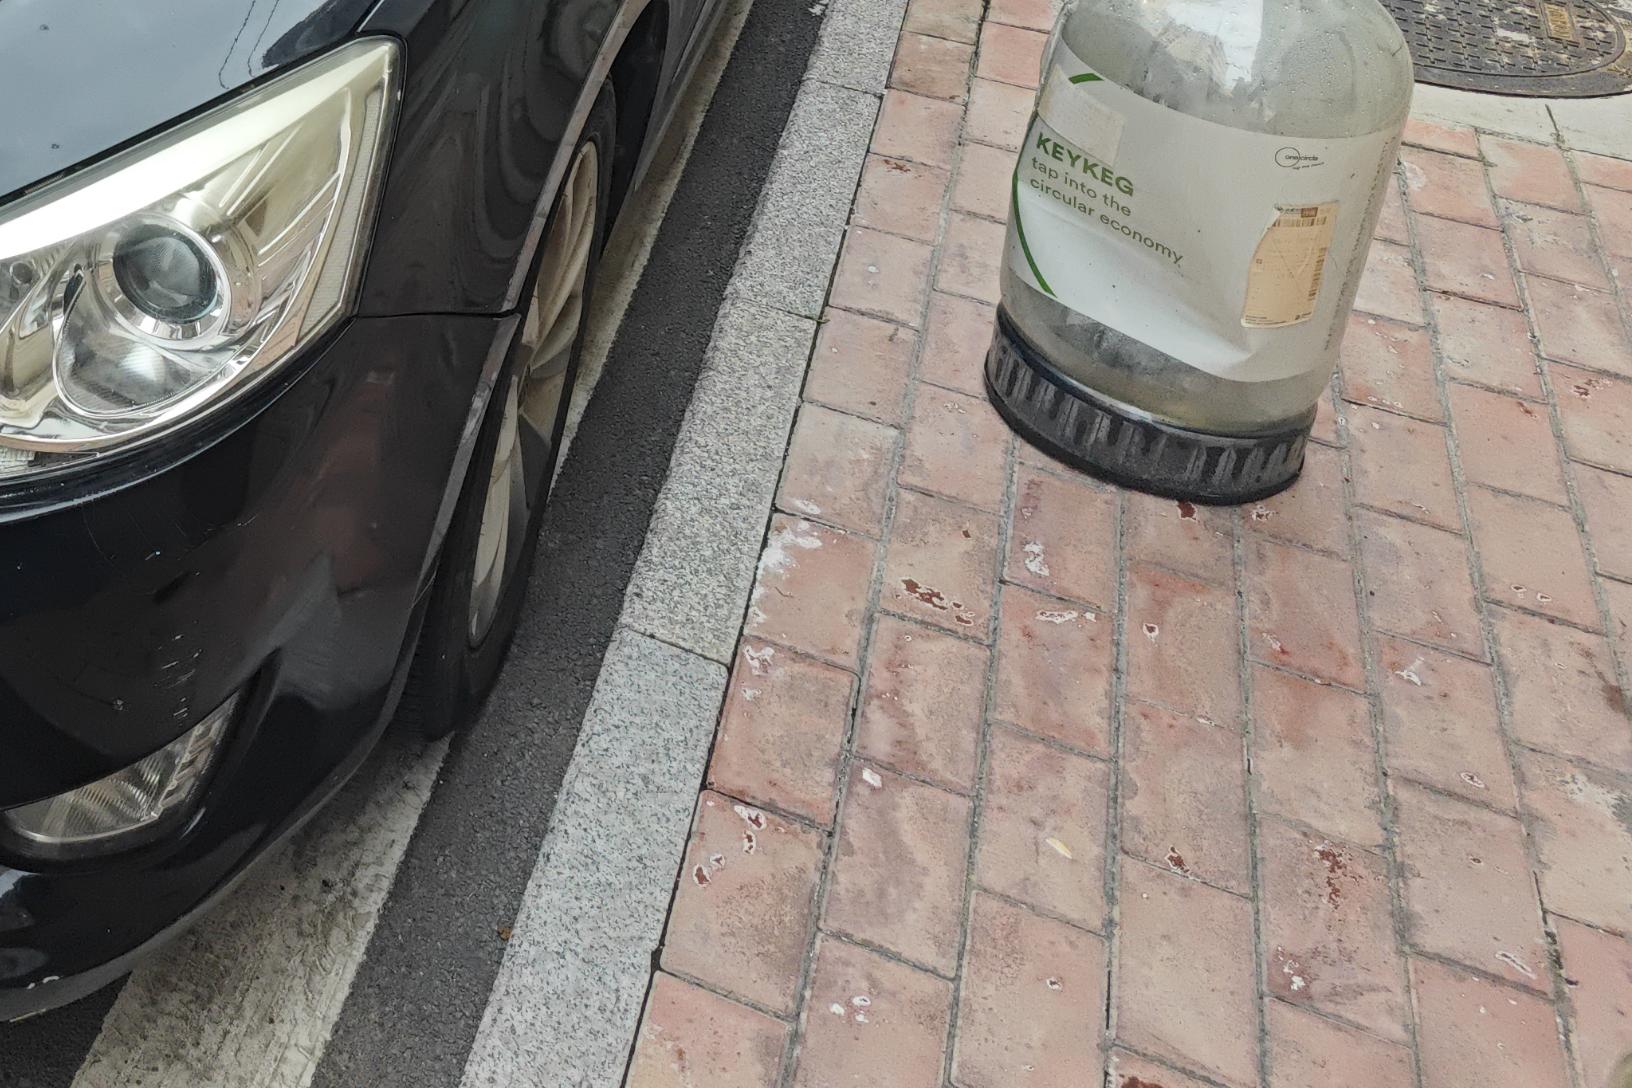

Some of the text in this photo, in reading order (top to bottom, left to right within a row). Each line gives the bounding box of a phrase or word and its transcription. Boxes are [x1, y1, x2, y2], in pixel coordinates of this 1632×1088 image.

[1032, 156, 1131, 217] tap into the
[1036, 132, 1134, 197] KEYKEG
[1030, 177, 1183, 264] circular economy
